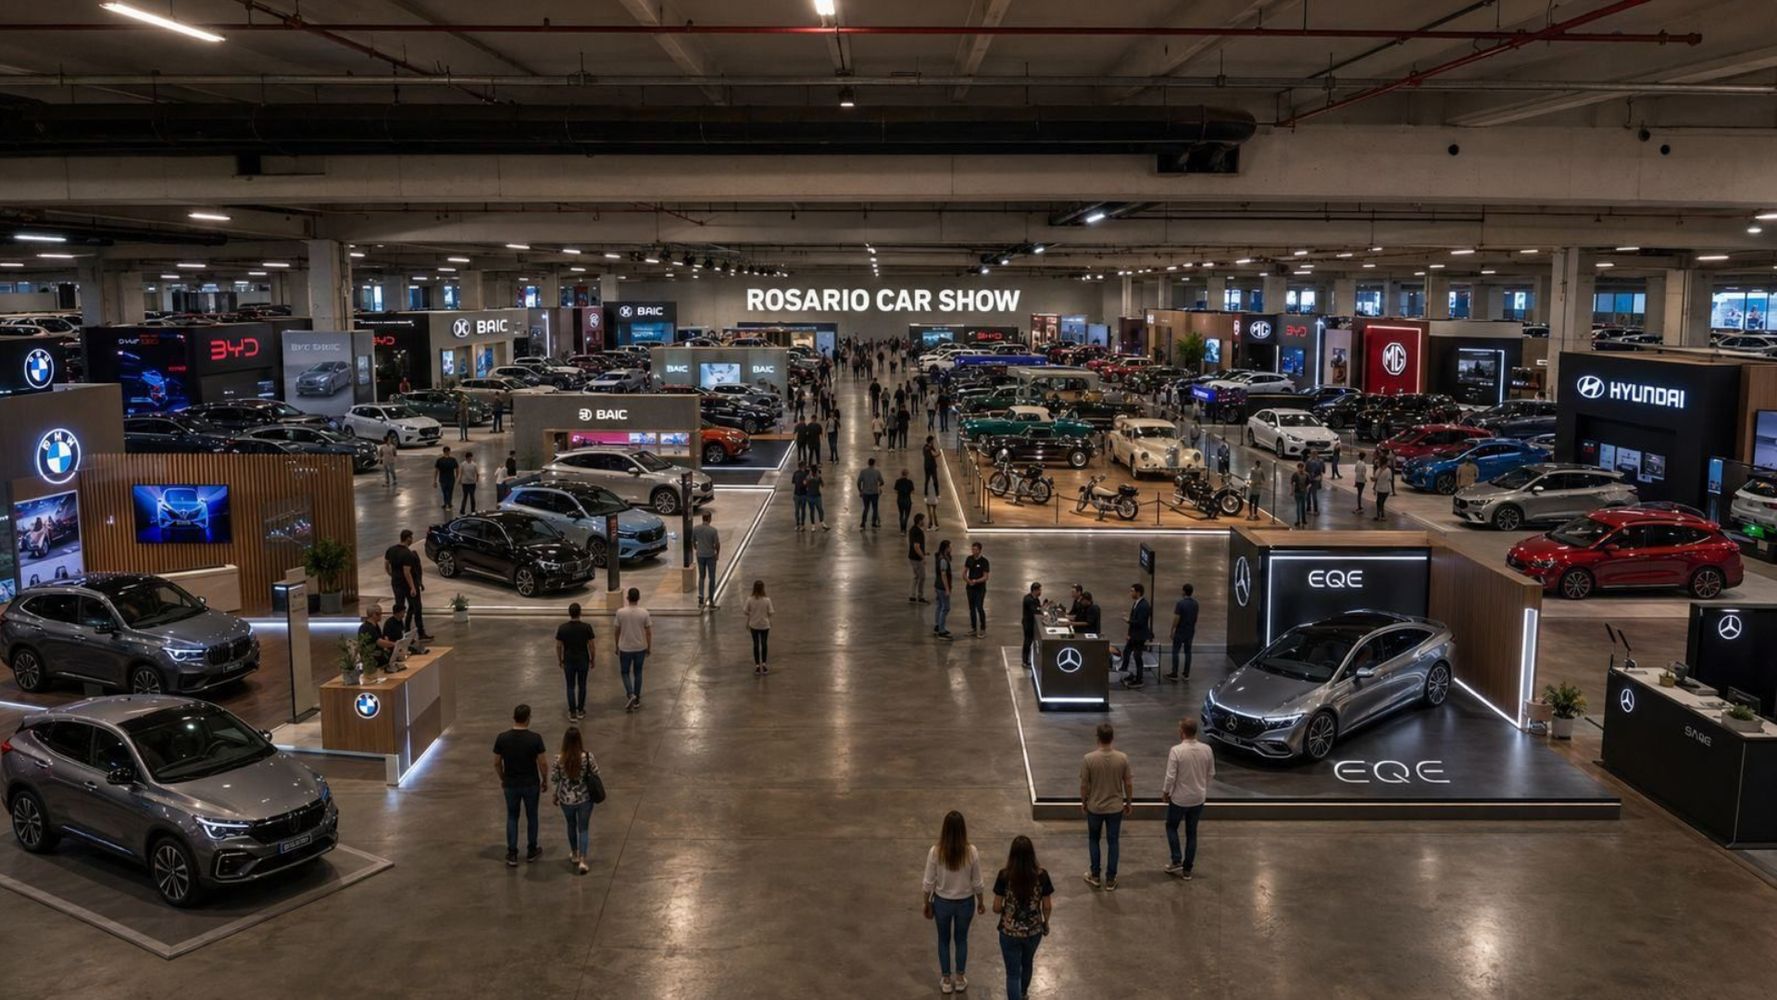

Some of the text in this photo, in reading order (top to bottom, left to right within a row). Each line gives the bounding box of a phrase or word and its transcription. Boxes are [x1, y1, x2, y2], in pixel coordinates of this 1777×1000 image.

[747, 288, 1021, 312] ROSARIO CAR SHOW
[637, 306, 663, 316] BAIC
[476, 319, 508, 334] BAIC
[1252, 322, 1270, 337] MG
[1286, 325, 1307, 337] BYD
[210, 338, 259, 360] BYD
[1385, 345, 1404, 371] MG
[666, 365, 688, 373] BAIC
[752, 365, 774, 373] BAIC
[1610, 381, 1685, 408] HYUNDAI
[596, 409, 628, 420] BAIC
[1308, 570, 1363, 588] EQE
[1334, 760, 1451, 783] EQE
